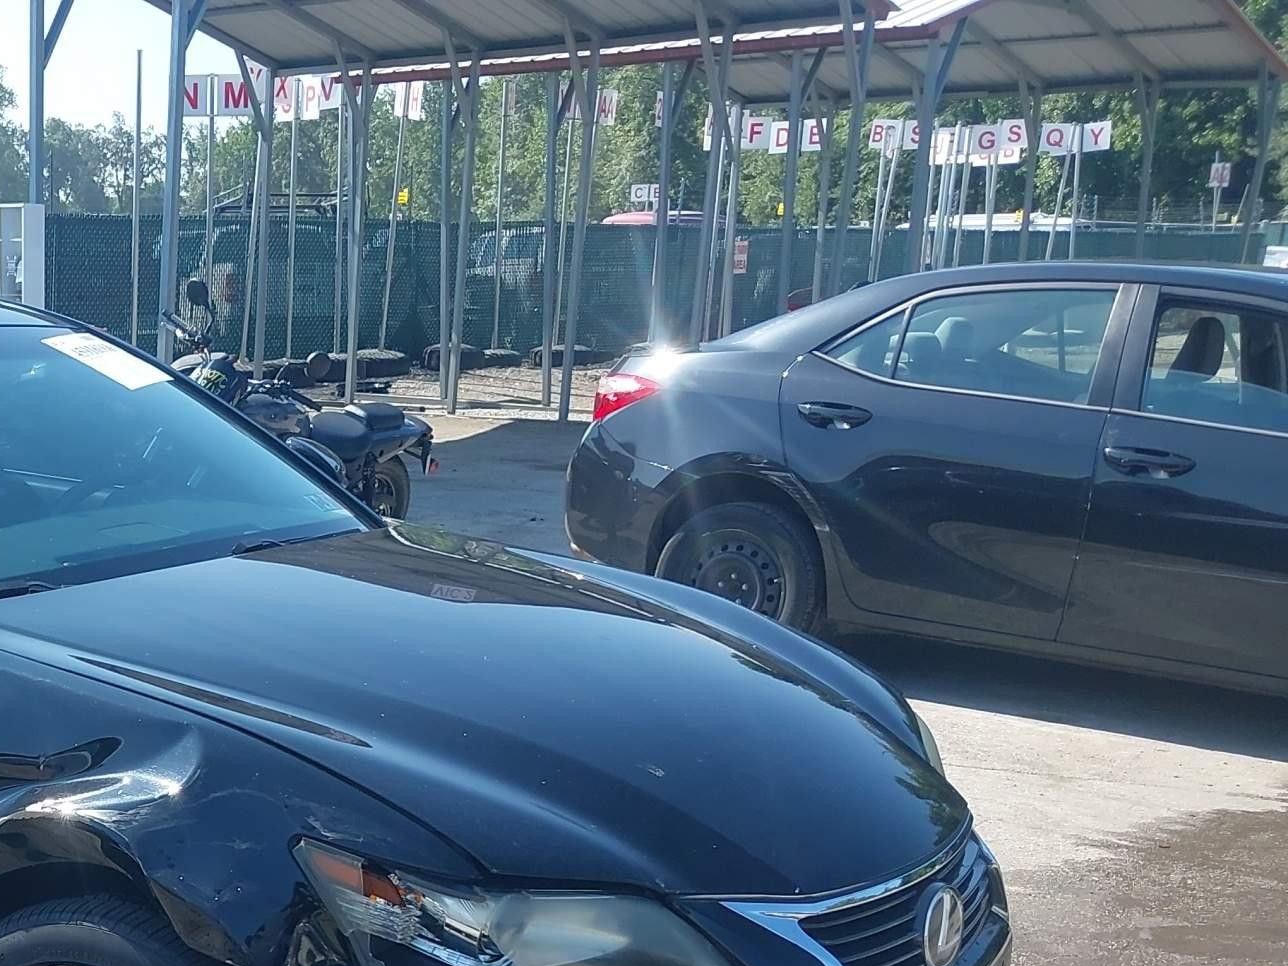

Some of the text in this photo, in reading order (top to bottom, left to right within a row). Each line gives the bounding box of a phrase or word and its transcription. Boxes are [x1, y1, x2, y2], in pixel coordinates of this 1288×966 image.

[224, 81, 249, 109] M
[749, 122, 764, 144] F
[775, 127, 789, 147] D
[872, 124, 884, 143] B
[978, 130, 996, 150] G
[1008, 124, 1022, 143] S
[1046, 128, 1064, 148] Q
[1090, 126, 1105, 146] Y
[634, 187, 644, 199] C
